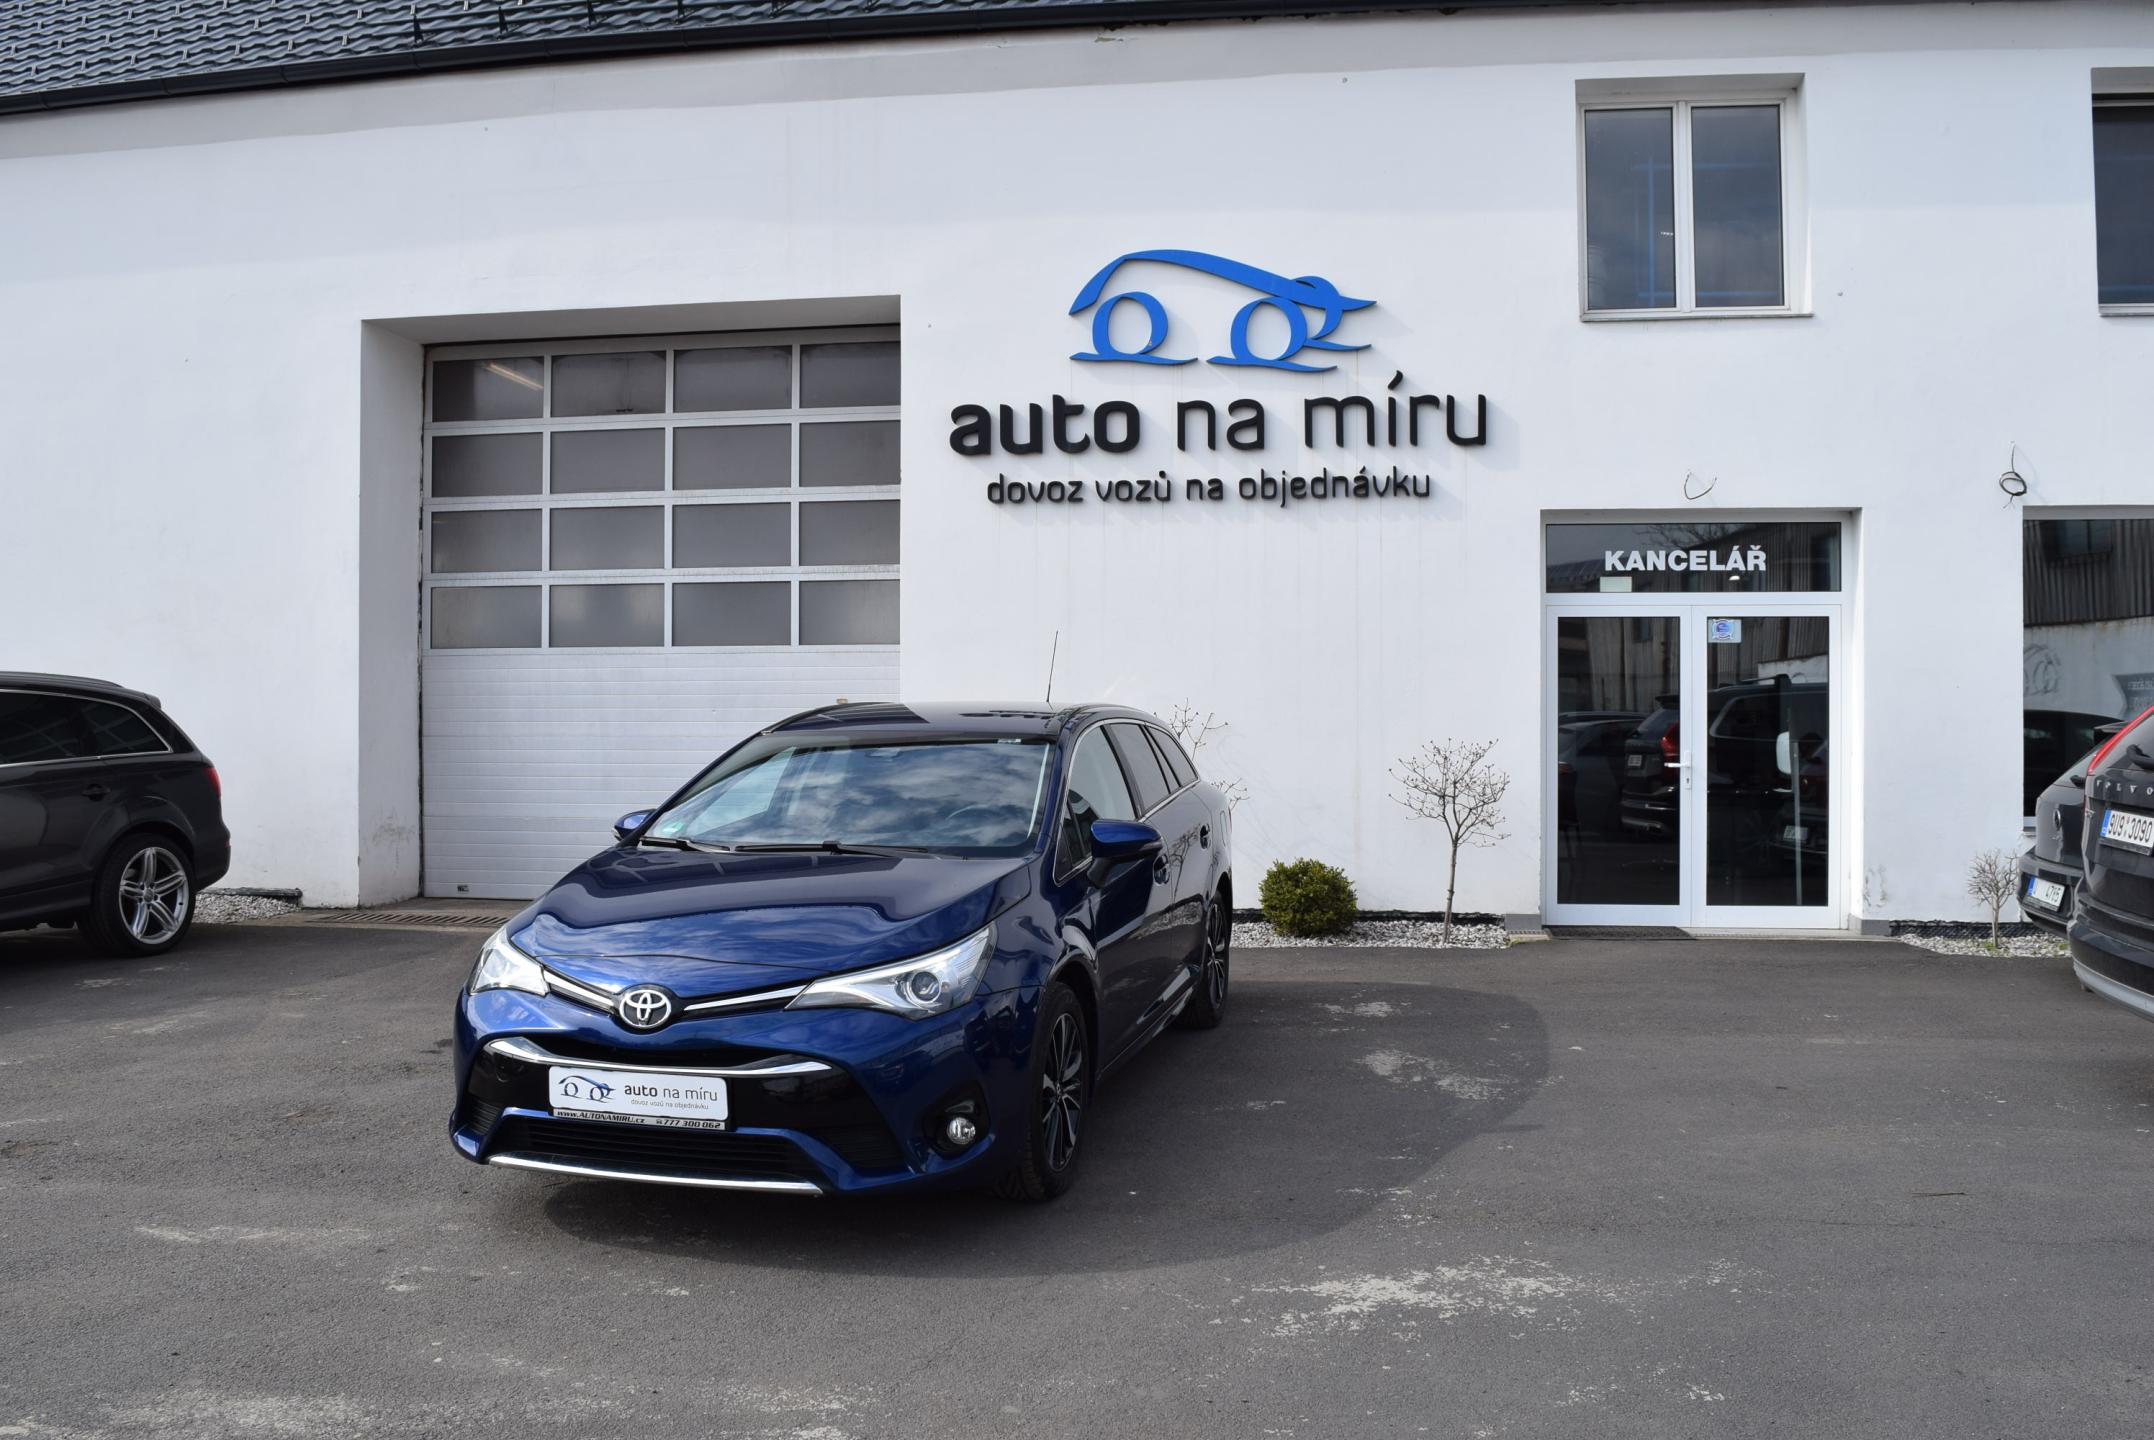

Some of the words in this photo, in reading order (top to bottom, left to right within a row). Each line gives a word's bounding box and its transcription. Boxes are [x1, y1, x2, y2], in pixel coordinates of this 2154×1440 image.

[949, 394, 1141, 456] auto
[1177, 399, 1265, 452] na
[1303, 370, 1487, 448] míru
[987, 473, 1083, 505] dovoz
[1095, 470, 1171, 503] vozů
[1186, 475, 1224, 502] na
[1239, 466, 1431, 509] objednávku
[1604, 545, 1767, 572] KANCELÁŘ
[2128, 818, 2153, 843] 3090
[624, 1084, 658, 1098] auto
[663, 1088, 680, 1099] na
[685, 1086, 718, 1102] míru
[682, 1120, 701, 1128] 300
[702, 1121, 722, 1129] 062
